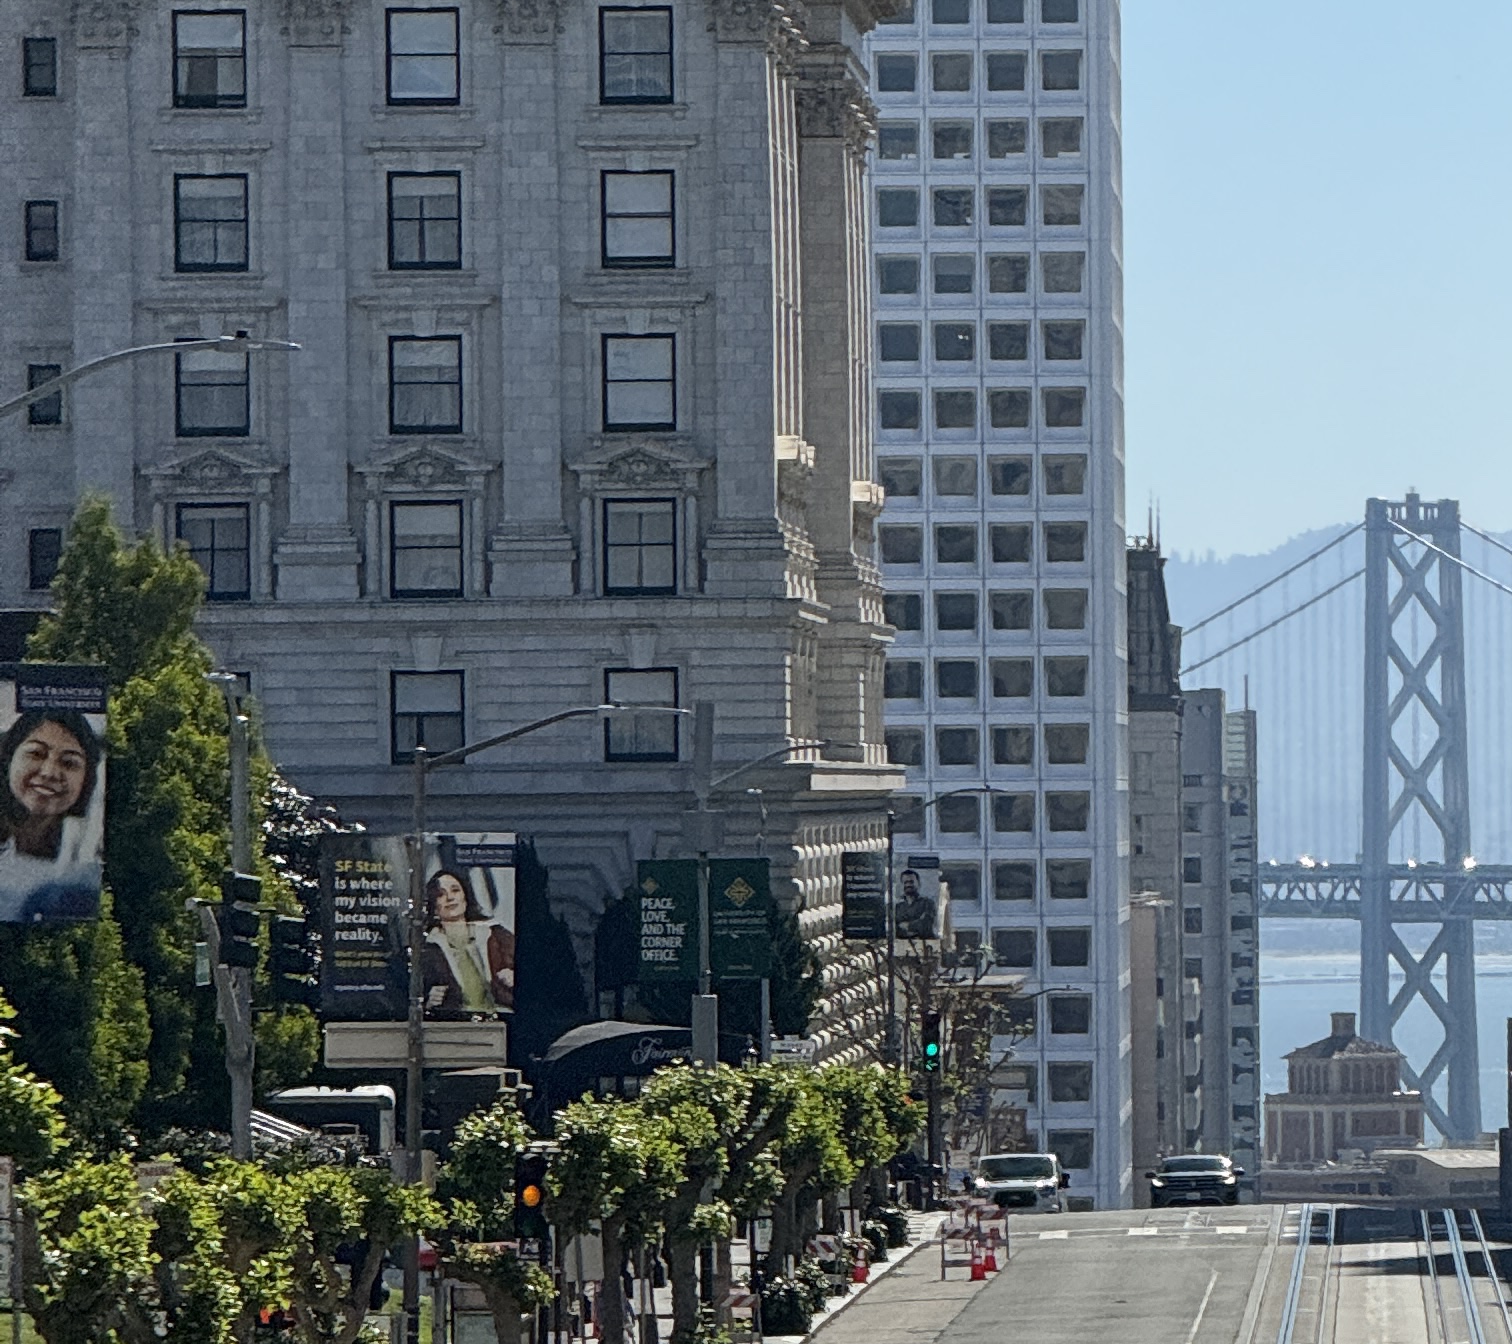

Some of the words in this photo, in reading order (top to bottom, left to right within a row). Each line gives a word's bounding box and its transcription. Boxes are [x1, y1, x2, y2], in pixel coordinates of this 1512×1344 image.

[335, 860, 352, 873] SF
[355, 860, 392, 873] State
[334, 876, 347, 890] is
[350, 876, 393, 890] where
[334, 895, 356, 909] my
[359, 893, 400, 907] vision
[641, 897, 675, 910] PEACE,
[334, 911, 388, 925] became
[641, 923, 664, 935] AND
[666, 922, 687, 935] THE
[334, 927, 384, 945] reality.
[641, 936, 683, 949] CORNER
[641, 949, 679, 961] OFFICE.
